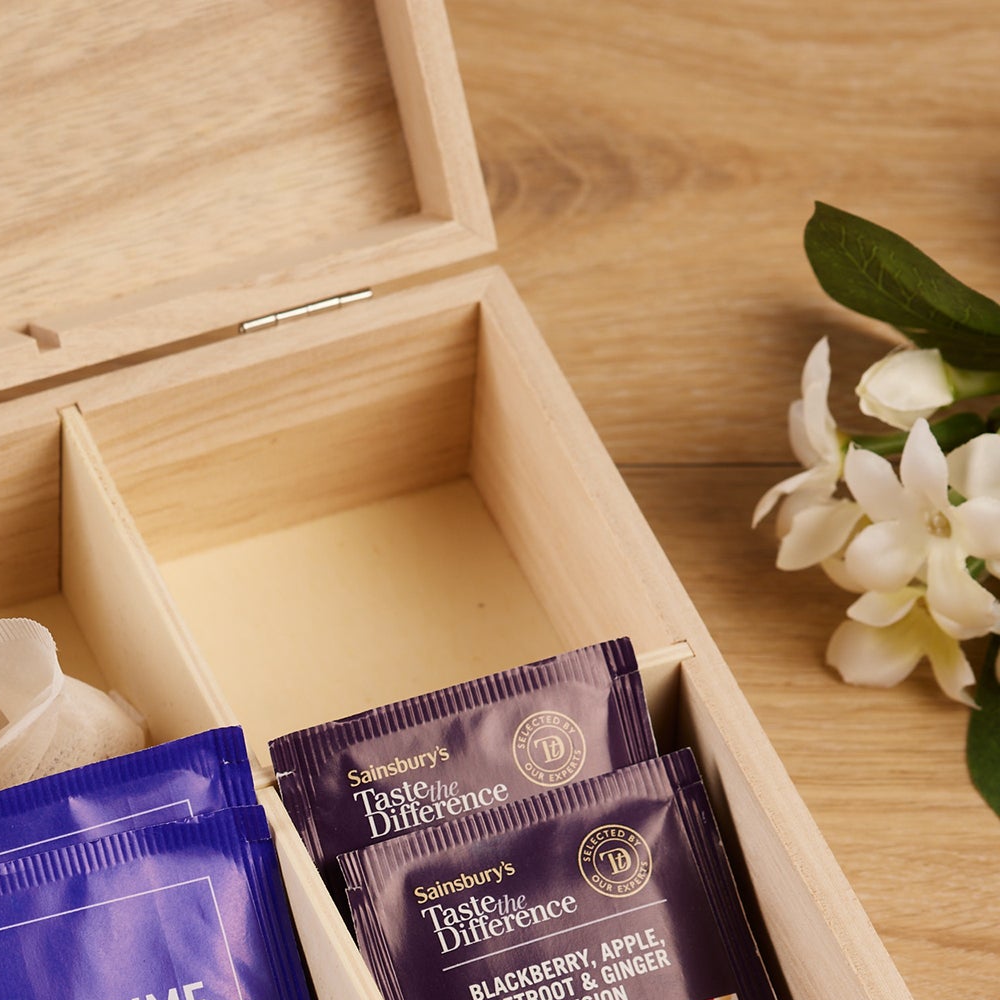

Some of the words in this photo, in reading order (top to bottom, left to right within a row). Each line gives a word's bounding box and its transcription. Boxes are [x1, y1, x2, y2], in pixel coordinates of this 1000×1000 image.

[517, 715, 560, 750] SELECTED
[562, 721, 577, 735] BY
[346, 745, 450, 788] Sainsbury's
[524, 763, 545, 782] OUR
[549, 748, 582, 783] EXPERTS
[353, 779, 430, 818] Taste
[428, 778, 460, 802] the
[367, 782, 509, 839] Difference
[583, 829, 625, 862] SELECTED
[627, 835, 642, 847] BY
[413, 861, 516, 904] Sainsbury's
[591, 874, 613, 892] OUR
[617, 861, 648, 893] EXPERTS
[421, 895, 497, 933] Taste
[496, 893, 528, 916] the
[436, 895, 578, 955] Difference
[599, 927, 667, 962] APPLE,
[580, 971, 599, 991] &
[601, 947, 672, 985] GINGER
